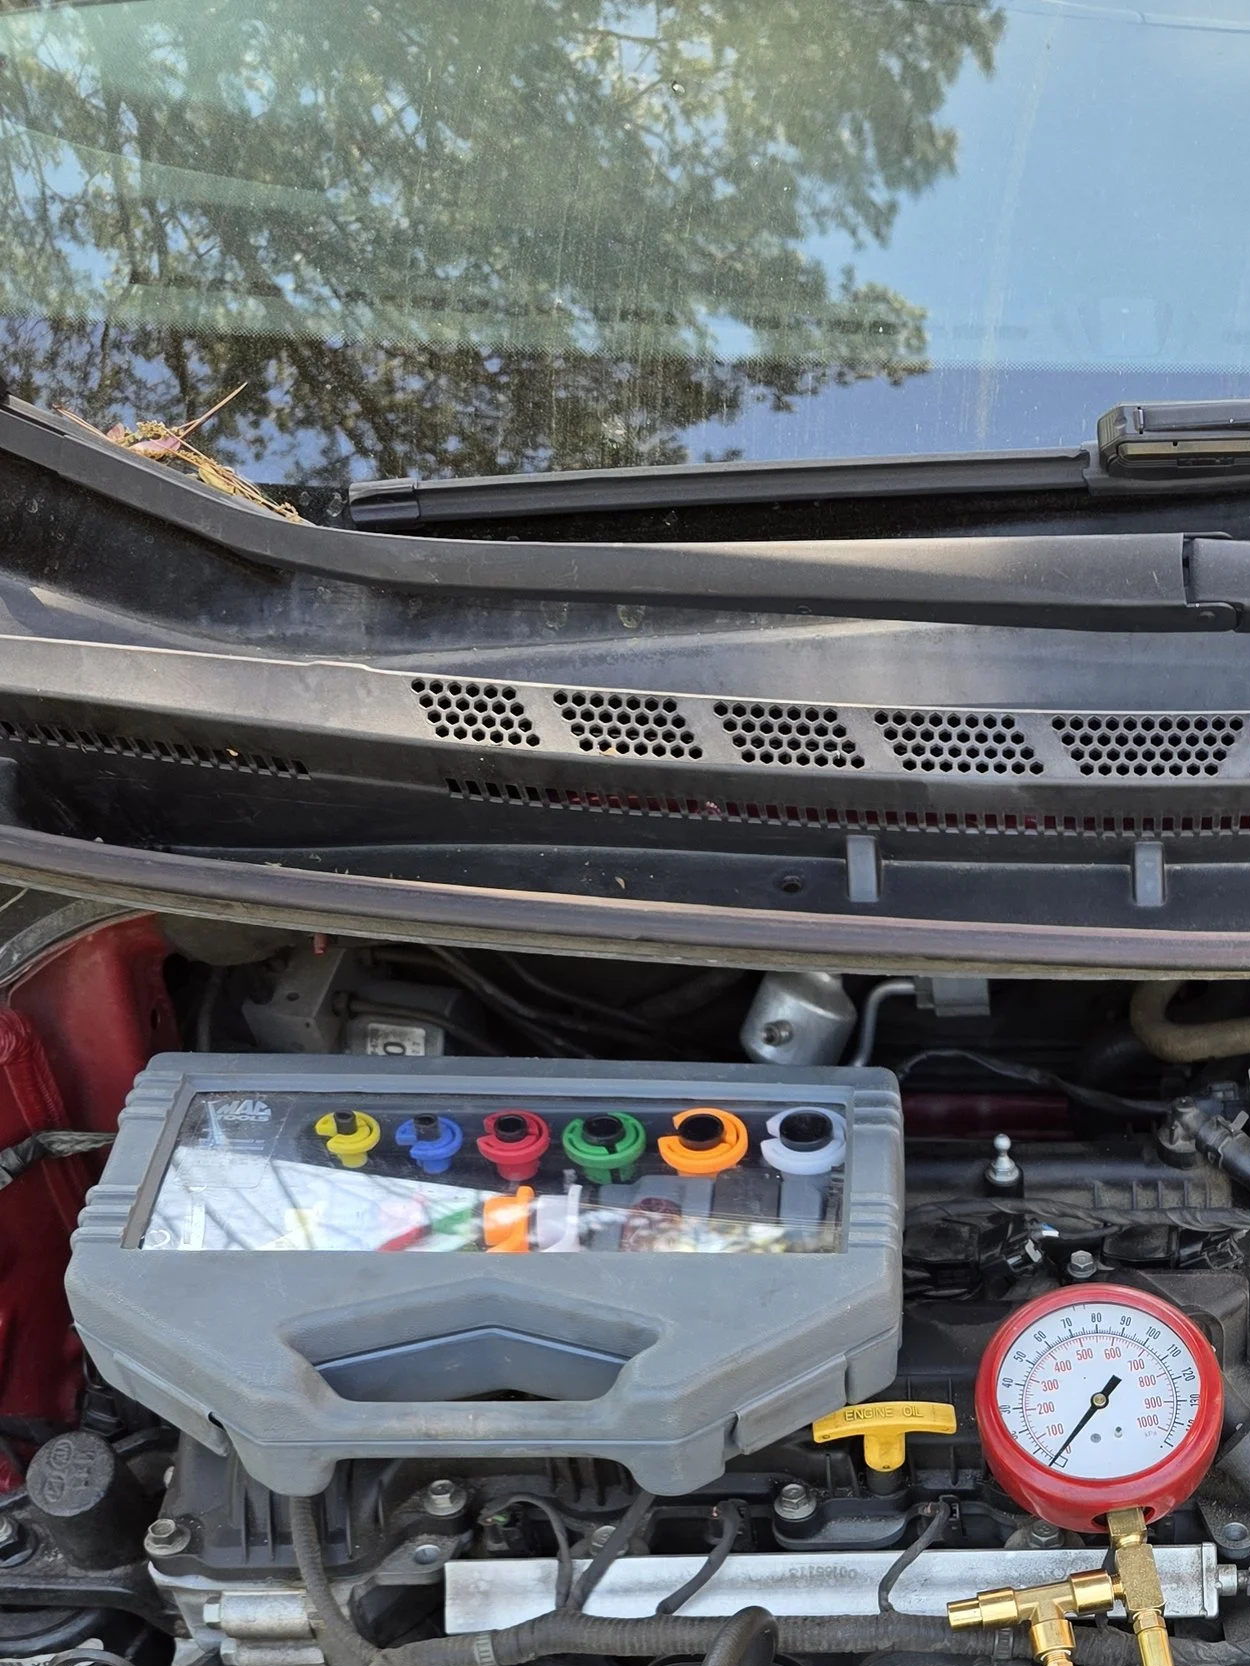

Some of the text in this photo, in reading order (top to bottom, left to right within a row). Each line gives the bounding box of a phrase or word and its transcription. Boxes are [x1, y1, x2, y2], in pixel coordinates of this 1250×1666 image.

[217, 1100, 271, 1115] MAC
[1061, 1317, 1073, 1328] 70
[1091, 1313, 1102, 1323] 80
[1120, 1315, 1132, 1327] 90
[1033, 1331, 1047, 1342] 60
[1146, 1326, 1160, 1340] 100
[1014, 1351, 1027, 1363] 50
[1076, 1348, 1093, 1361] 500
[1104, 1347, 1122, 1359] 600
[1167, 1344, 1181, 1358] 110
[1054, 1361, 1072, 1372] 400
[1128, 1359, 1145, 1371] 700
[1182, 1366, 1195, 1382] 120
[1002, 1377, 1014, 1388] 40
[1042, 1379, 1059, 1391] 300
[1139, 1375, 1156, 1387] 800
[1037, 1402, 1055, 1414] 200
[1145, 1396, 1162, 1409] 900
[845, 1406, 924, 1421] ENGINE OIL
[1137, 1415, 1159, 1428] 1000
[1047, 1423, 1064, 1436] 100
